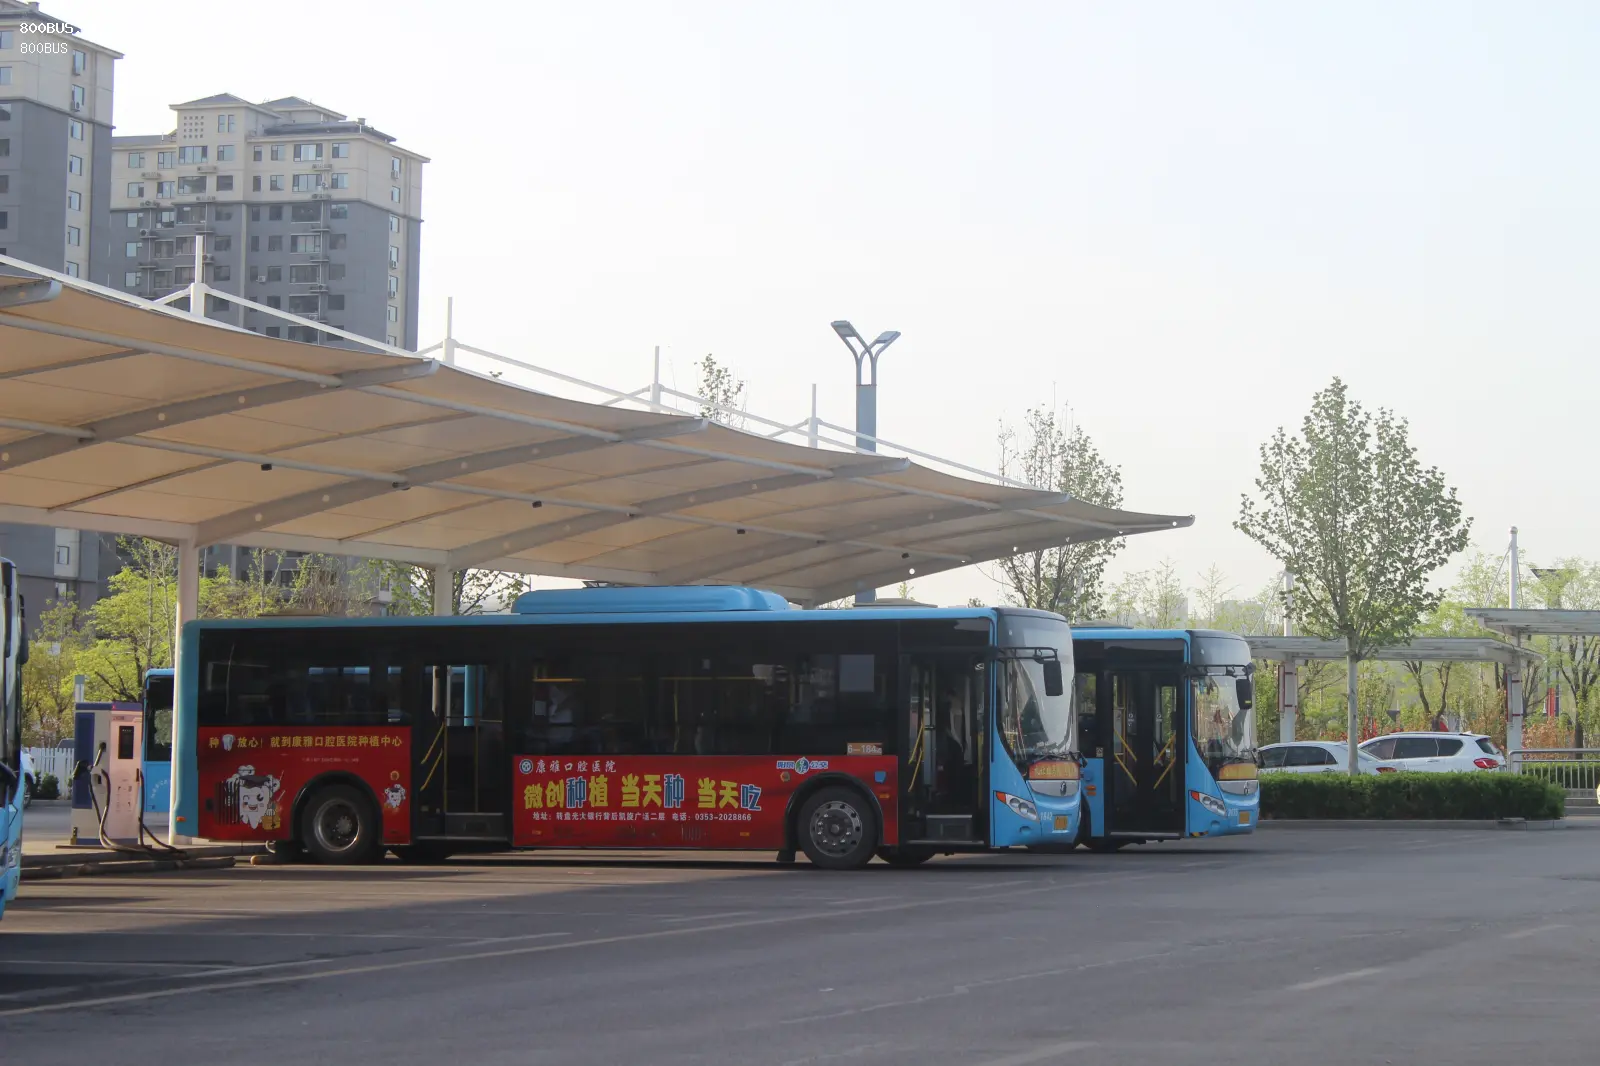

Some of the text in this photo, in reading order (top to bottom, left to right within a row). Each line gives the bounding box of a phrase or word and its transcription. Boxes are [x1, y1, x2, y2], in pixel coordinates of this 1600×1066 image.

[535, 759, 617, 774] 康雅口腔医院
[524, 773, 762, 812] 微创种植 当天种 当天吃
